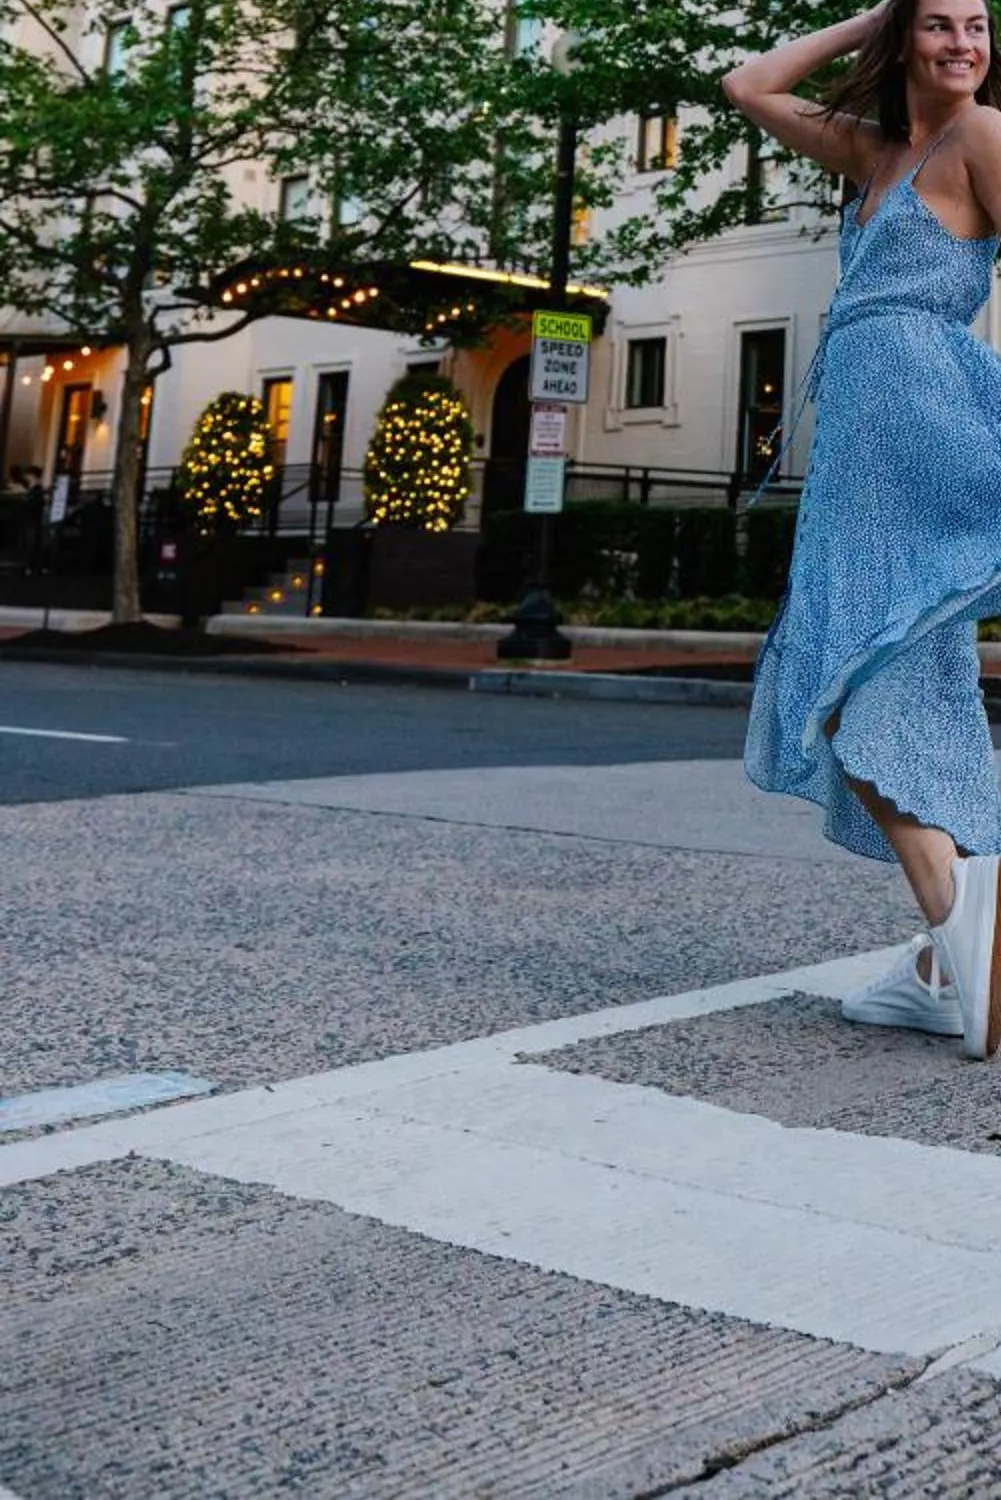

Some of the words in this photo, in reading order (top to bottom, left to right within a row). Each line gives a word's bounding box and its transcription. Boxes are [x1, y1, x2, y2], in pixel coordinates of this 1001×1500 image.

[540, 318, 585, 338] SCHOOL
[541, 341, 583, 357] SPEED
[543, 359, 577, 375] ZONE
[542, 379, 578, 396] AHEAD
